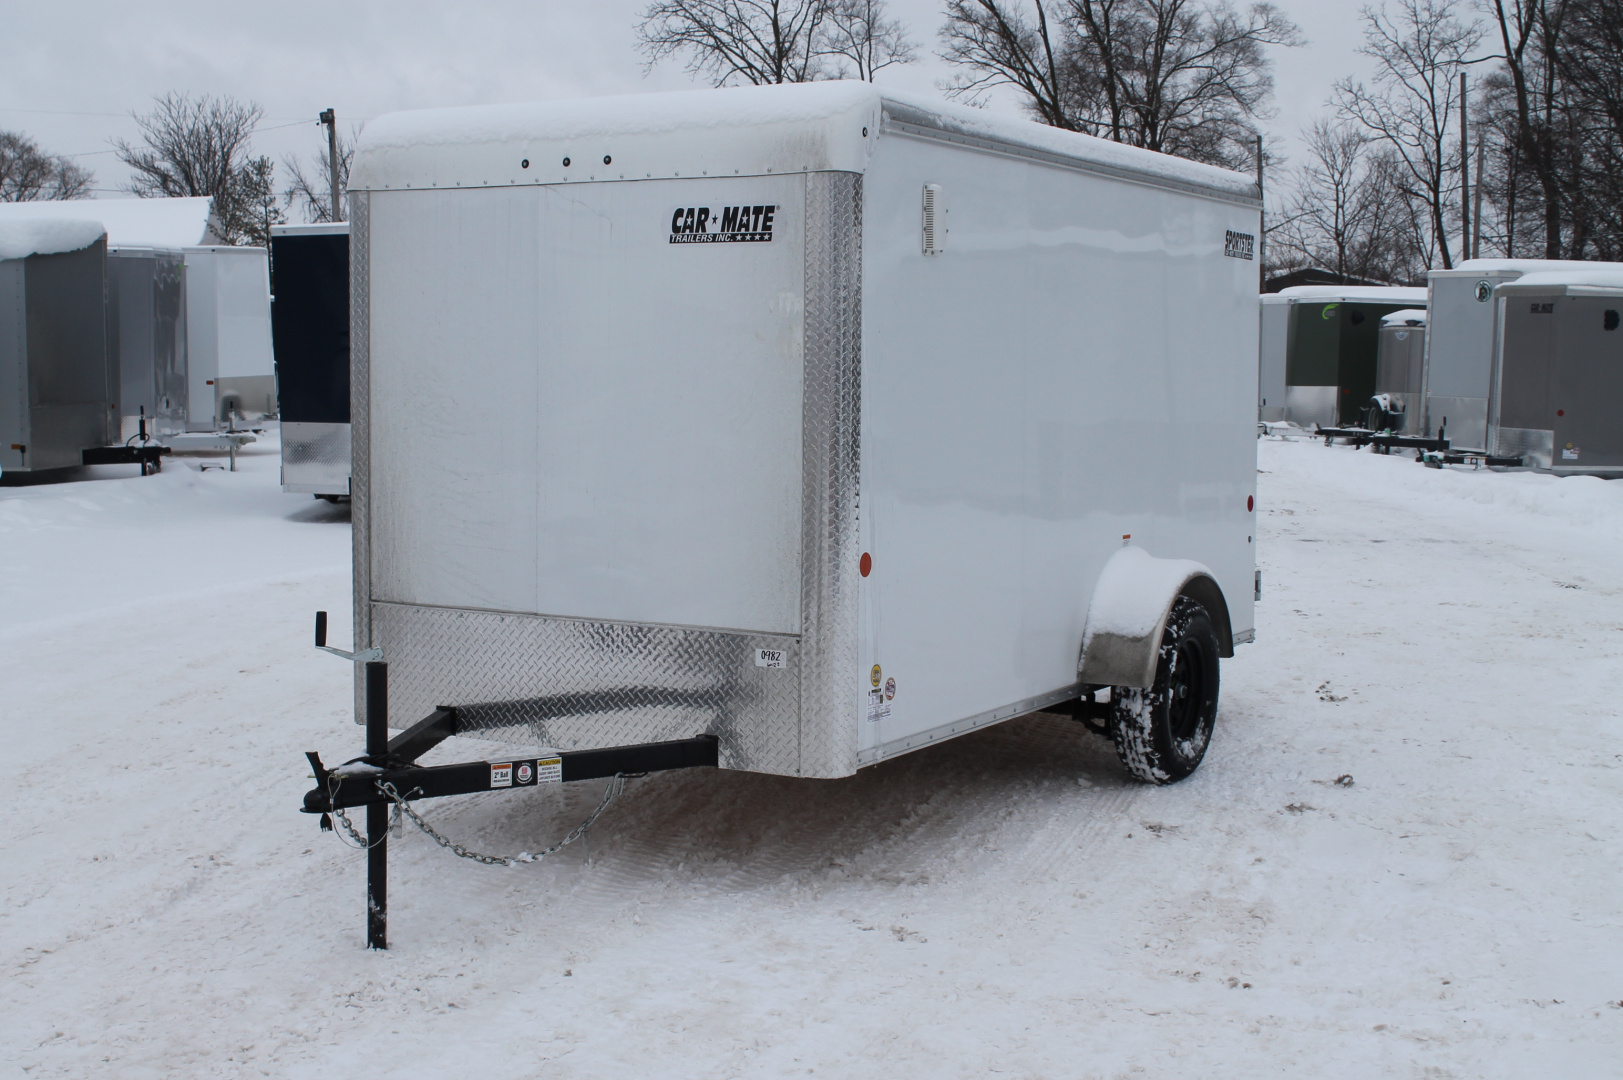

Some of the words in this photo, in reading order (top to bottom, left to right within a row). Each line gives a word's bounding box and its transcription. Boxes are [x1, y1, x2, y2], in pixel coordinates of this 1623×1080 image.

[671, 207, 710, 234] CAR
[720, 205, 776, 233] MATE
[671, 234, 713, 243] TRAILERS
[715, 233, 733, 242] INC.
[1225, 229, 1254, 254] SPORTSTER
[761, 650, 781, 662] 0982
